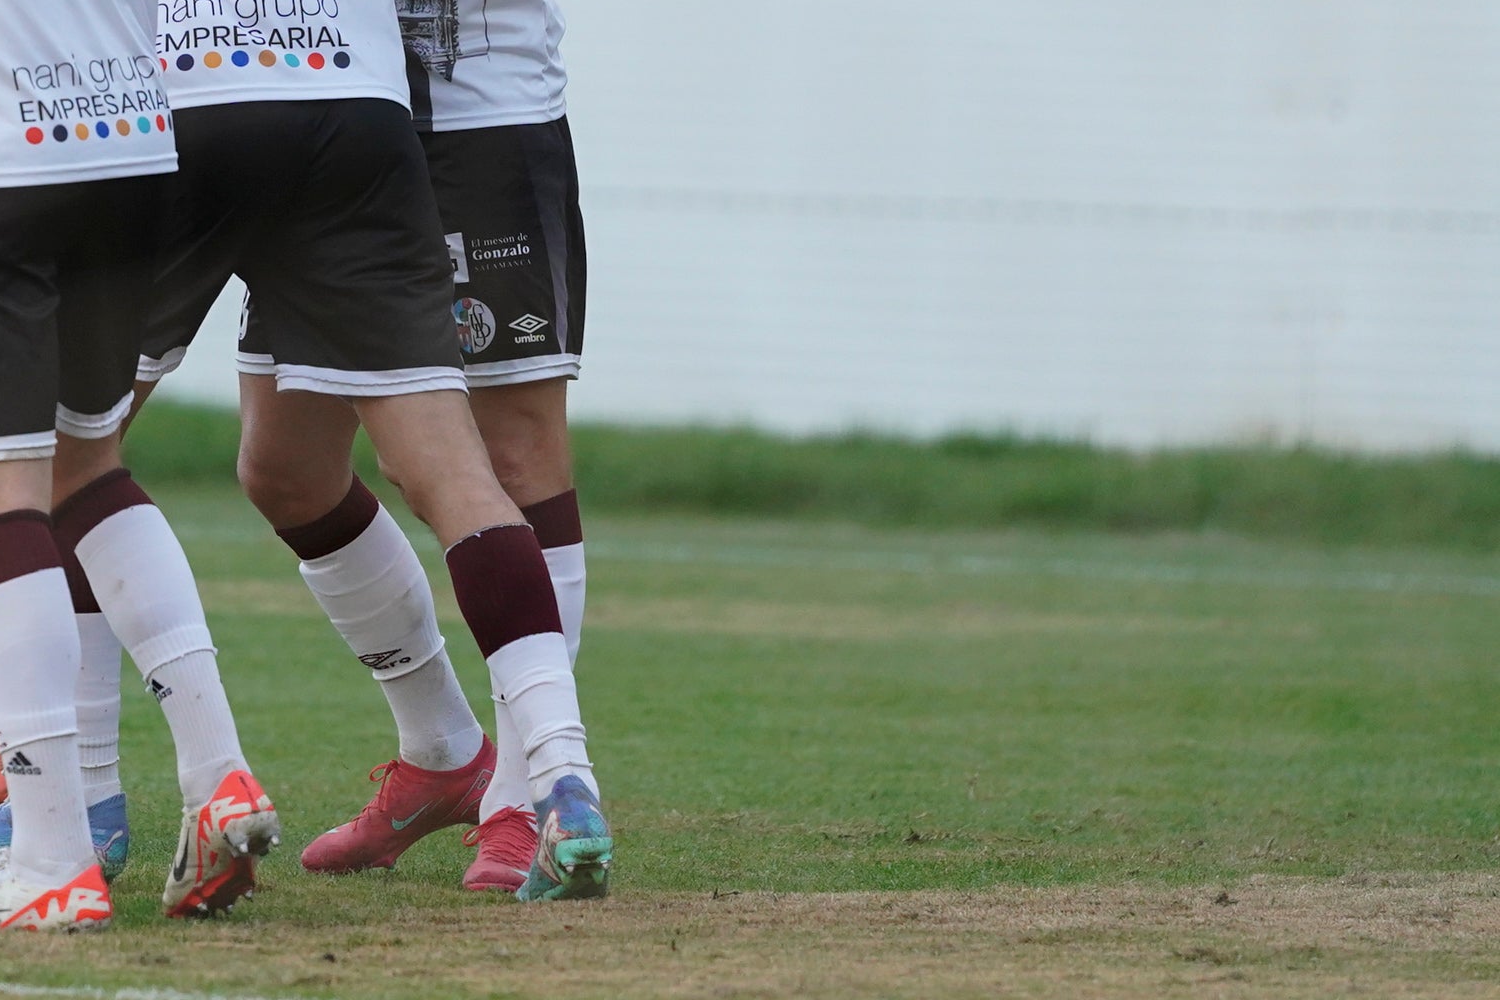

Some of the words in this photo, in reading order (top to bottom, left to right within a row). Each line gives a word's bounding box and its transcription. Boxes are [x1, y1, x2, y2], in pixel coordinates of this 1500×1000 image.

[12, 53, 83, 92] nani
[89, 54, 162, 93] grup
[517, 232, 529, 242] de
[472, 243, 531, 261] Gonzalo
[514, 333, 546, 344] umbro
